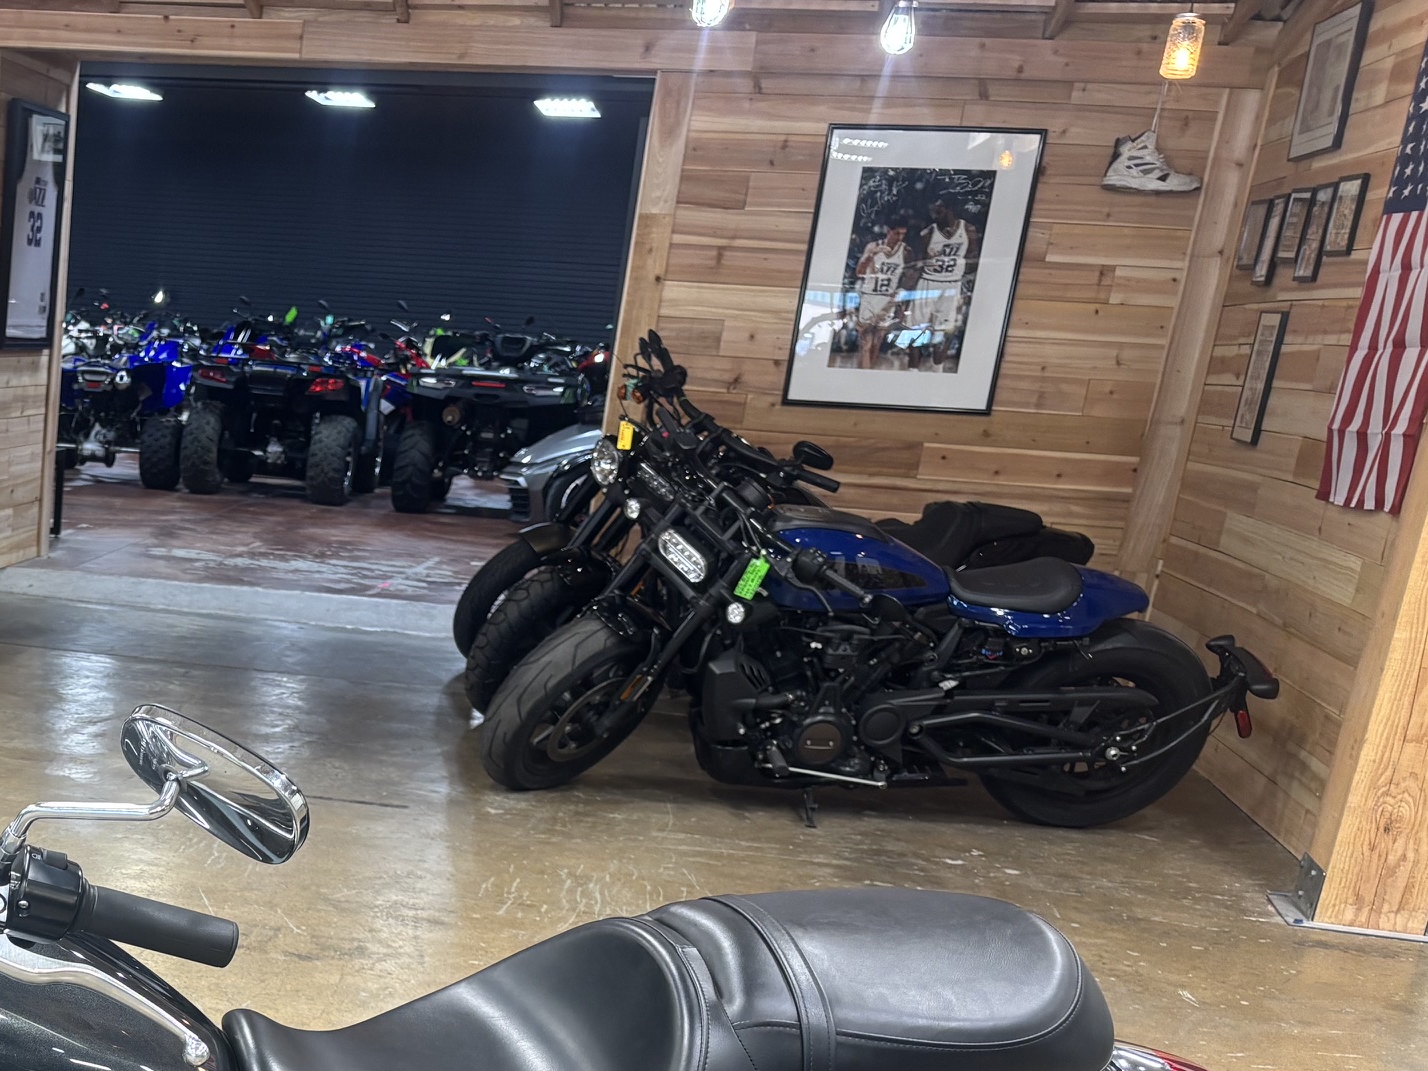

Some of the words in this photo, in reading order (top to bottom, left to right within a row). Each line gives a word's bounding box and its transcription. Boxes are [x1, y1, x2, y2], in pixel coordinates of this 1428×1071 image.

[27, 210, 43, 248] 32
[933, 257, 958, 274] 32
[872, 276, 892, 293] 12
